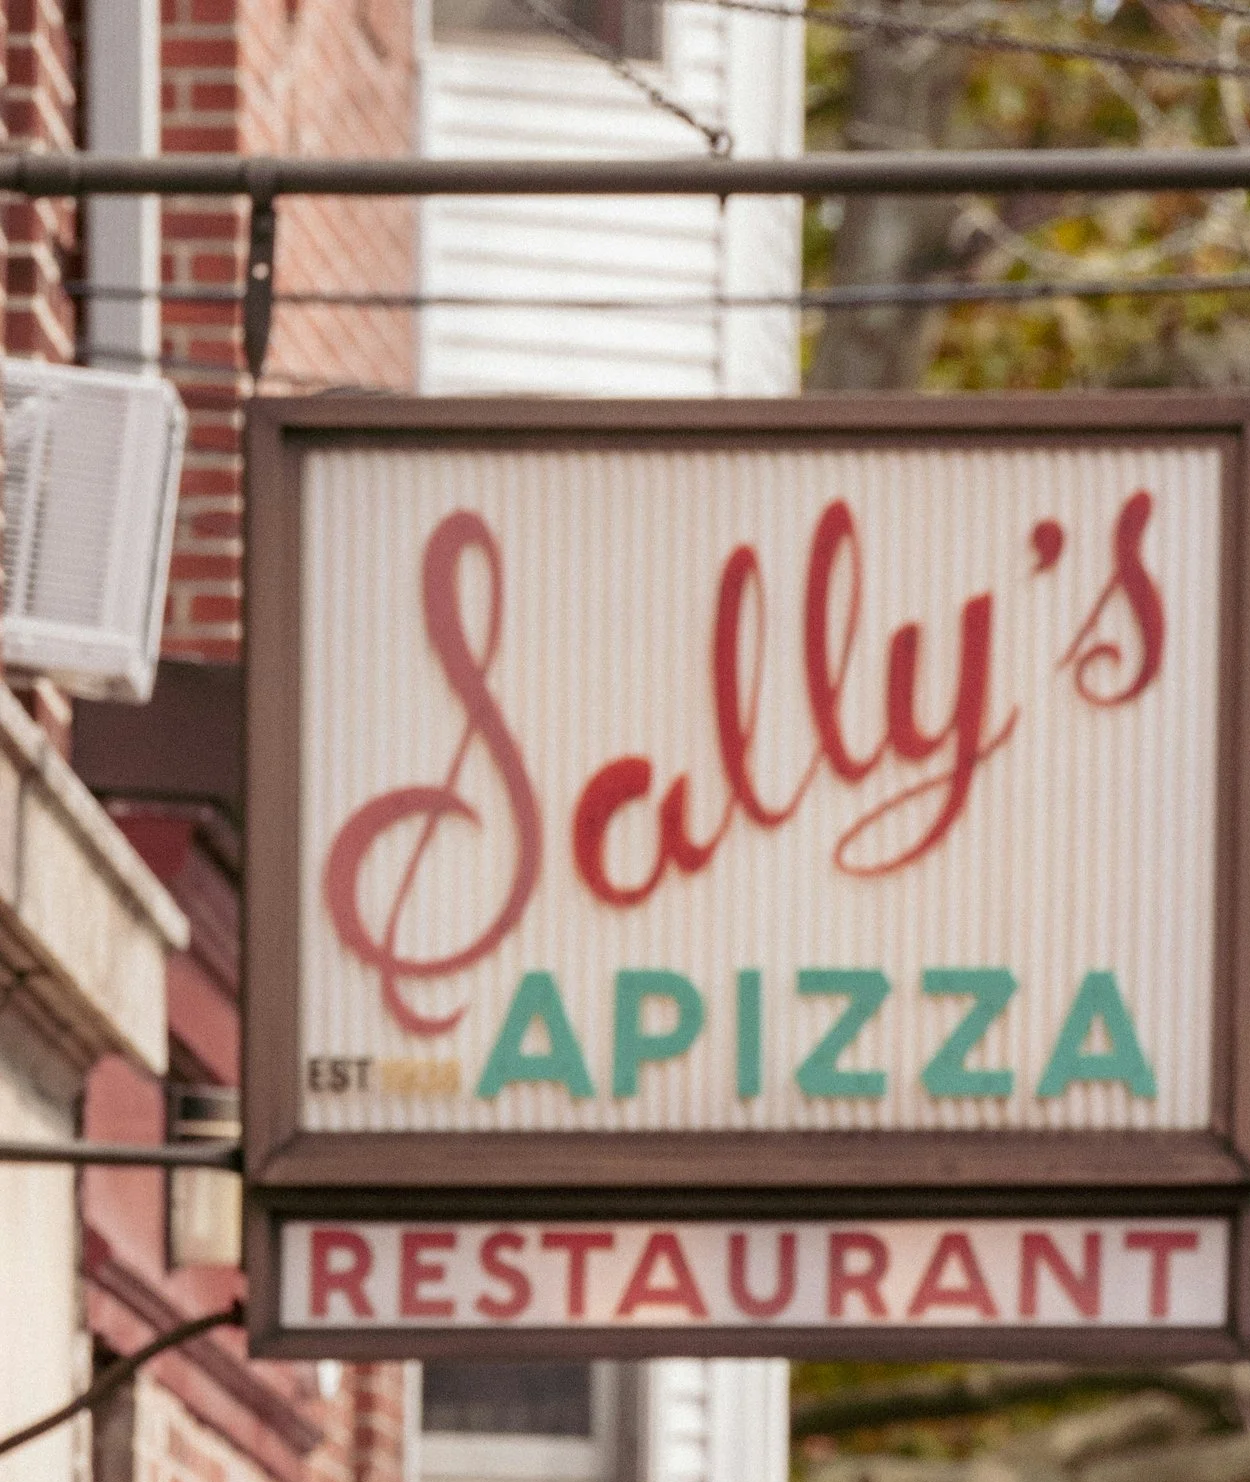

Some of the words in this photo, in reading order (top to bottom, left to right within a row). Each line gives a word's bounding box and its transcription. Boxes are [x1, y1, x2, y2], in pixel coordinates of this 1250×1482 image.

[323, 489, 1166, 1036] Sally's
[307, 1057, 372, 1094] EST
[475, 969, 1159, 1100] APIZZA
[309, 1230, 1198, 1319] RESTAURANT
